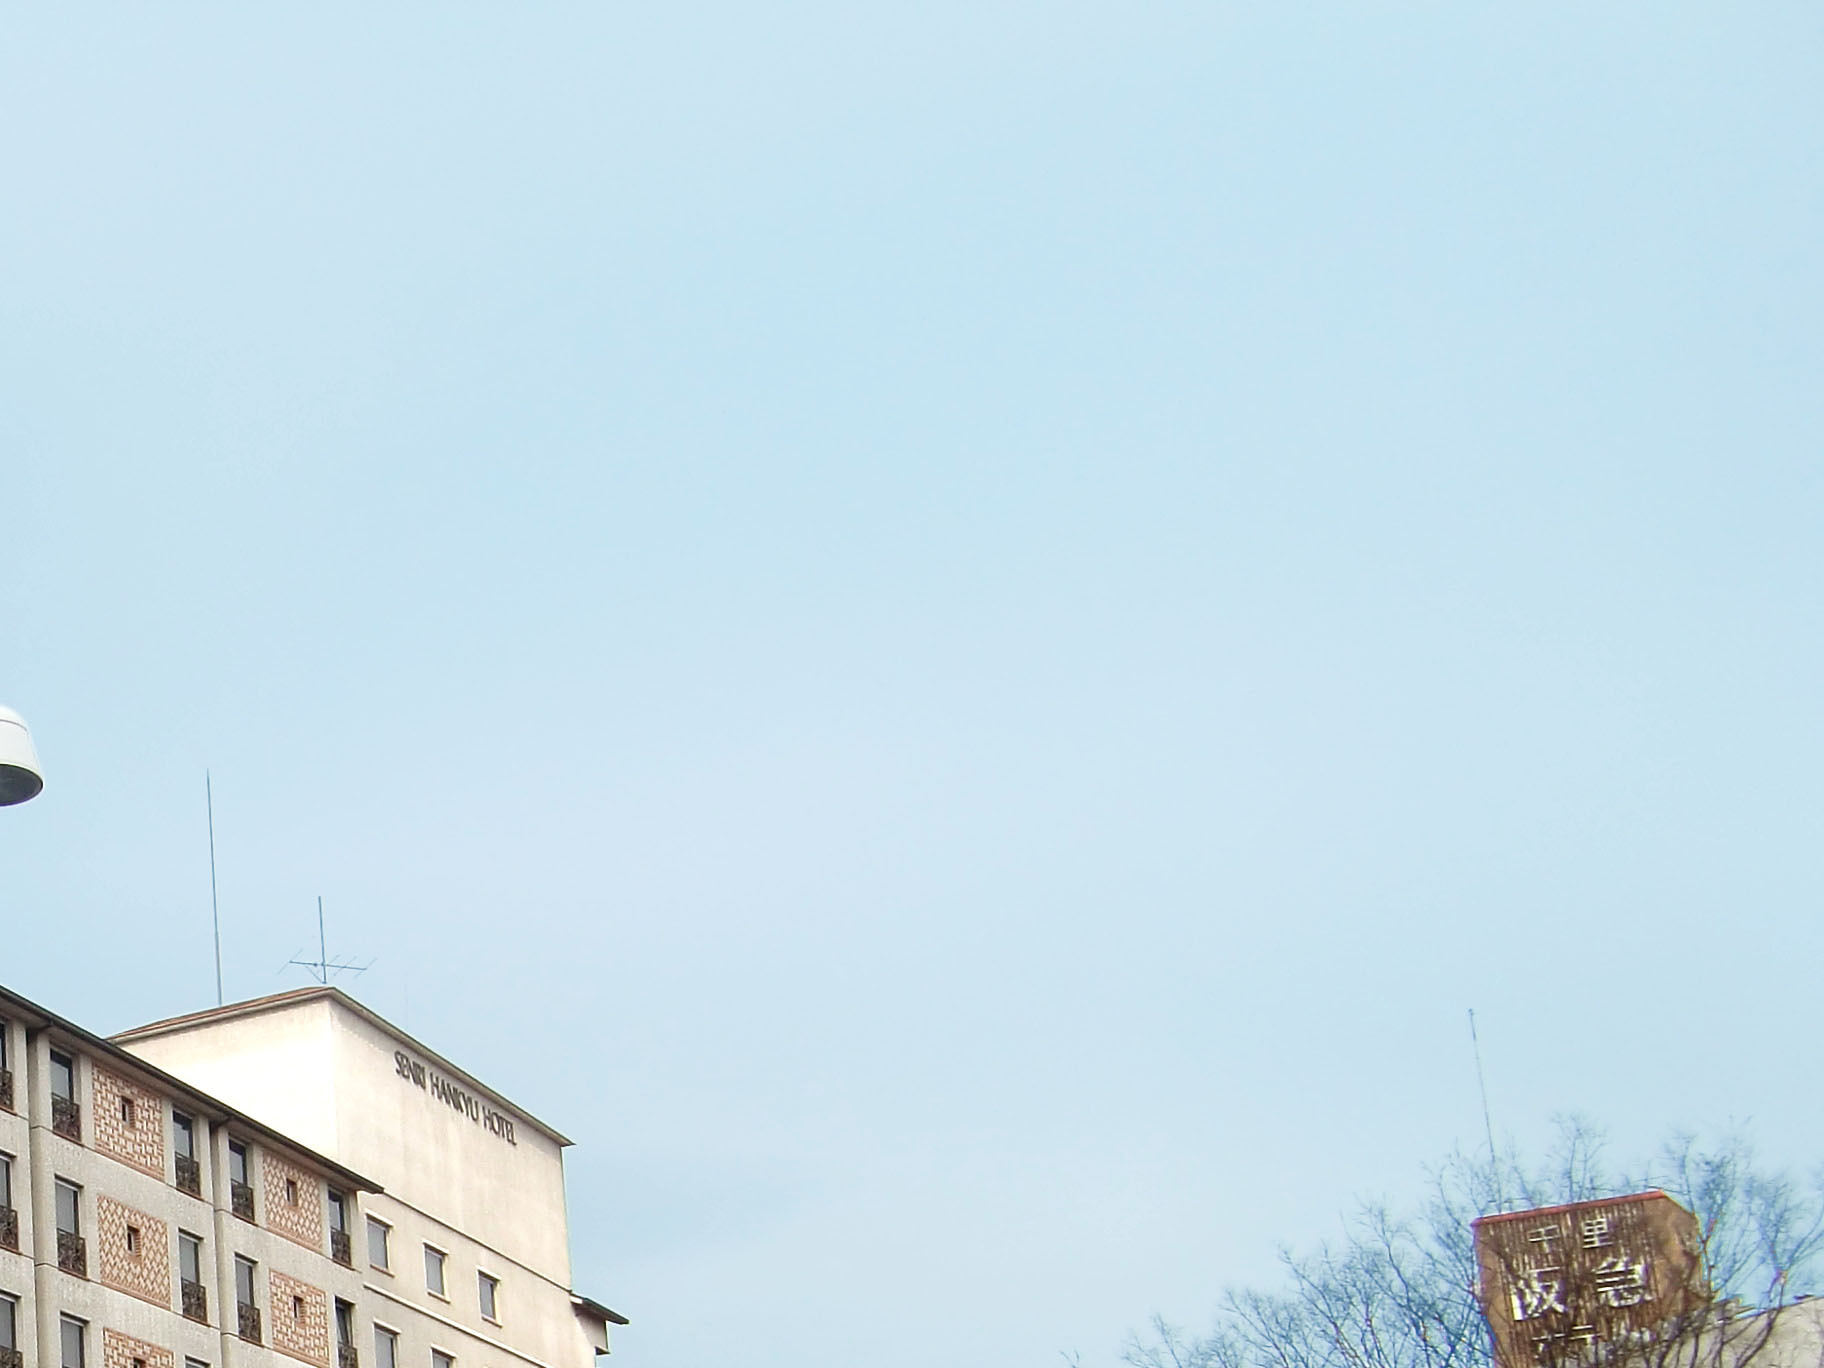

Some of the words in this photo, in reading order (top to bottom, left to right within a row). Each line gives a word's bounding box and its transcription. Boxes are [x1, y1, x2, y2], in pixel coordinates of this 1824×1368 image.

[394, 1051, 427, 1090] SENRI
[430, 1072, 480, 1121] HANKYU
[482, 1105, 518, 1145] HOTEL
